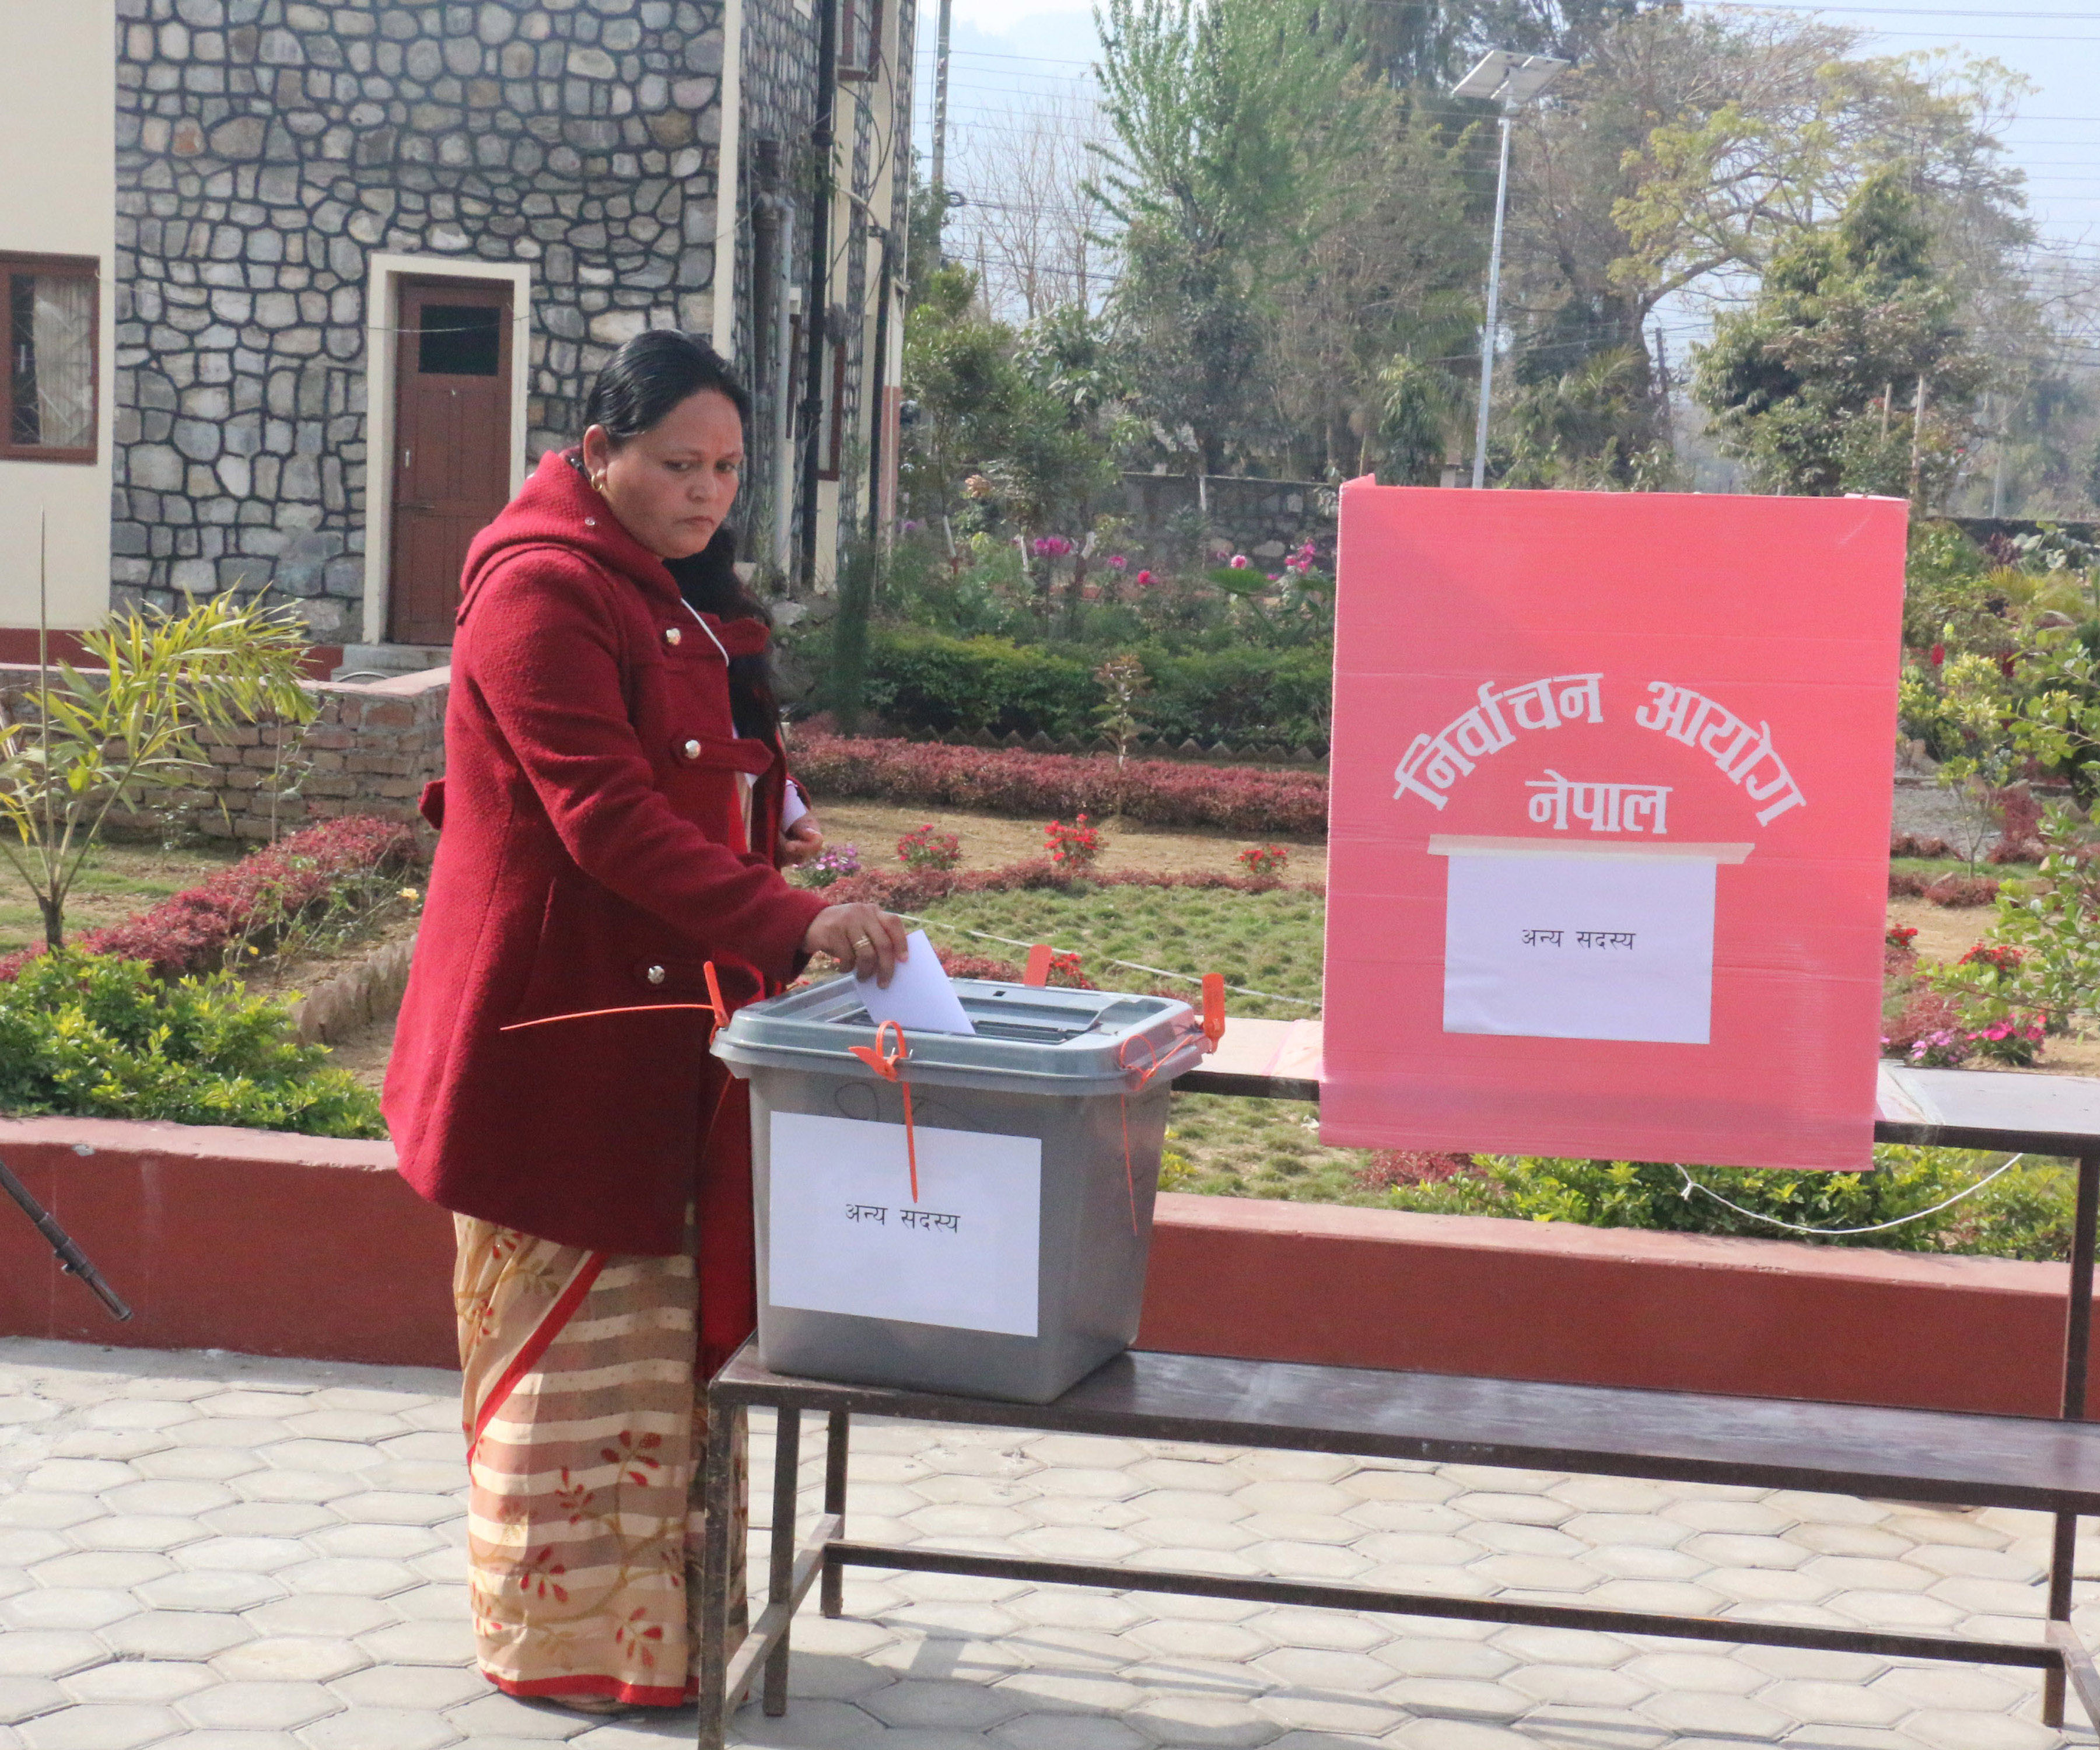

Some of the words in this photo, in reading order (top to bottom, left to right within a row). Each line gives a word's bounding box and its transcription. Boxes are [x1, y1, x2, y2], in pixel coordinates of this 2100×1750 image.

[1392, 672, 1604, 811] निर्वाचन
[1635, 680, 1807, 827] आयोग
[1524, 768, 1674, 834] नेपाल
[1522, 929, 1564, 948] अन्य
[1576, 931, 1636, 950] सदस्य
[846, 1204, 888, 1226] अन्य
[900, 1209, 961, 1234] सदस्य
